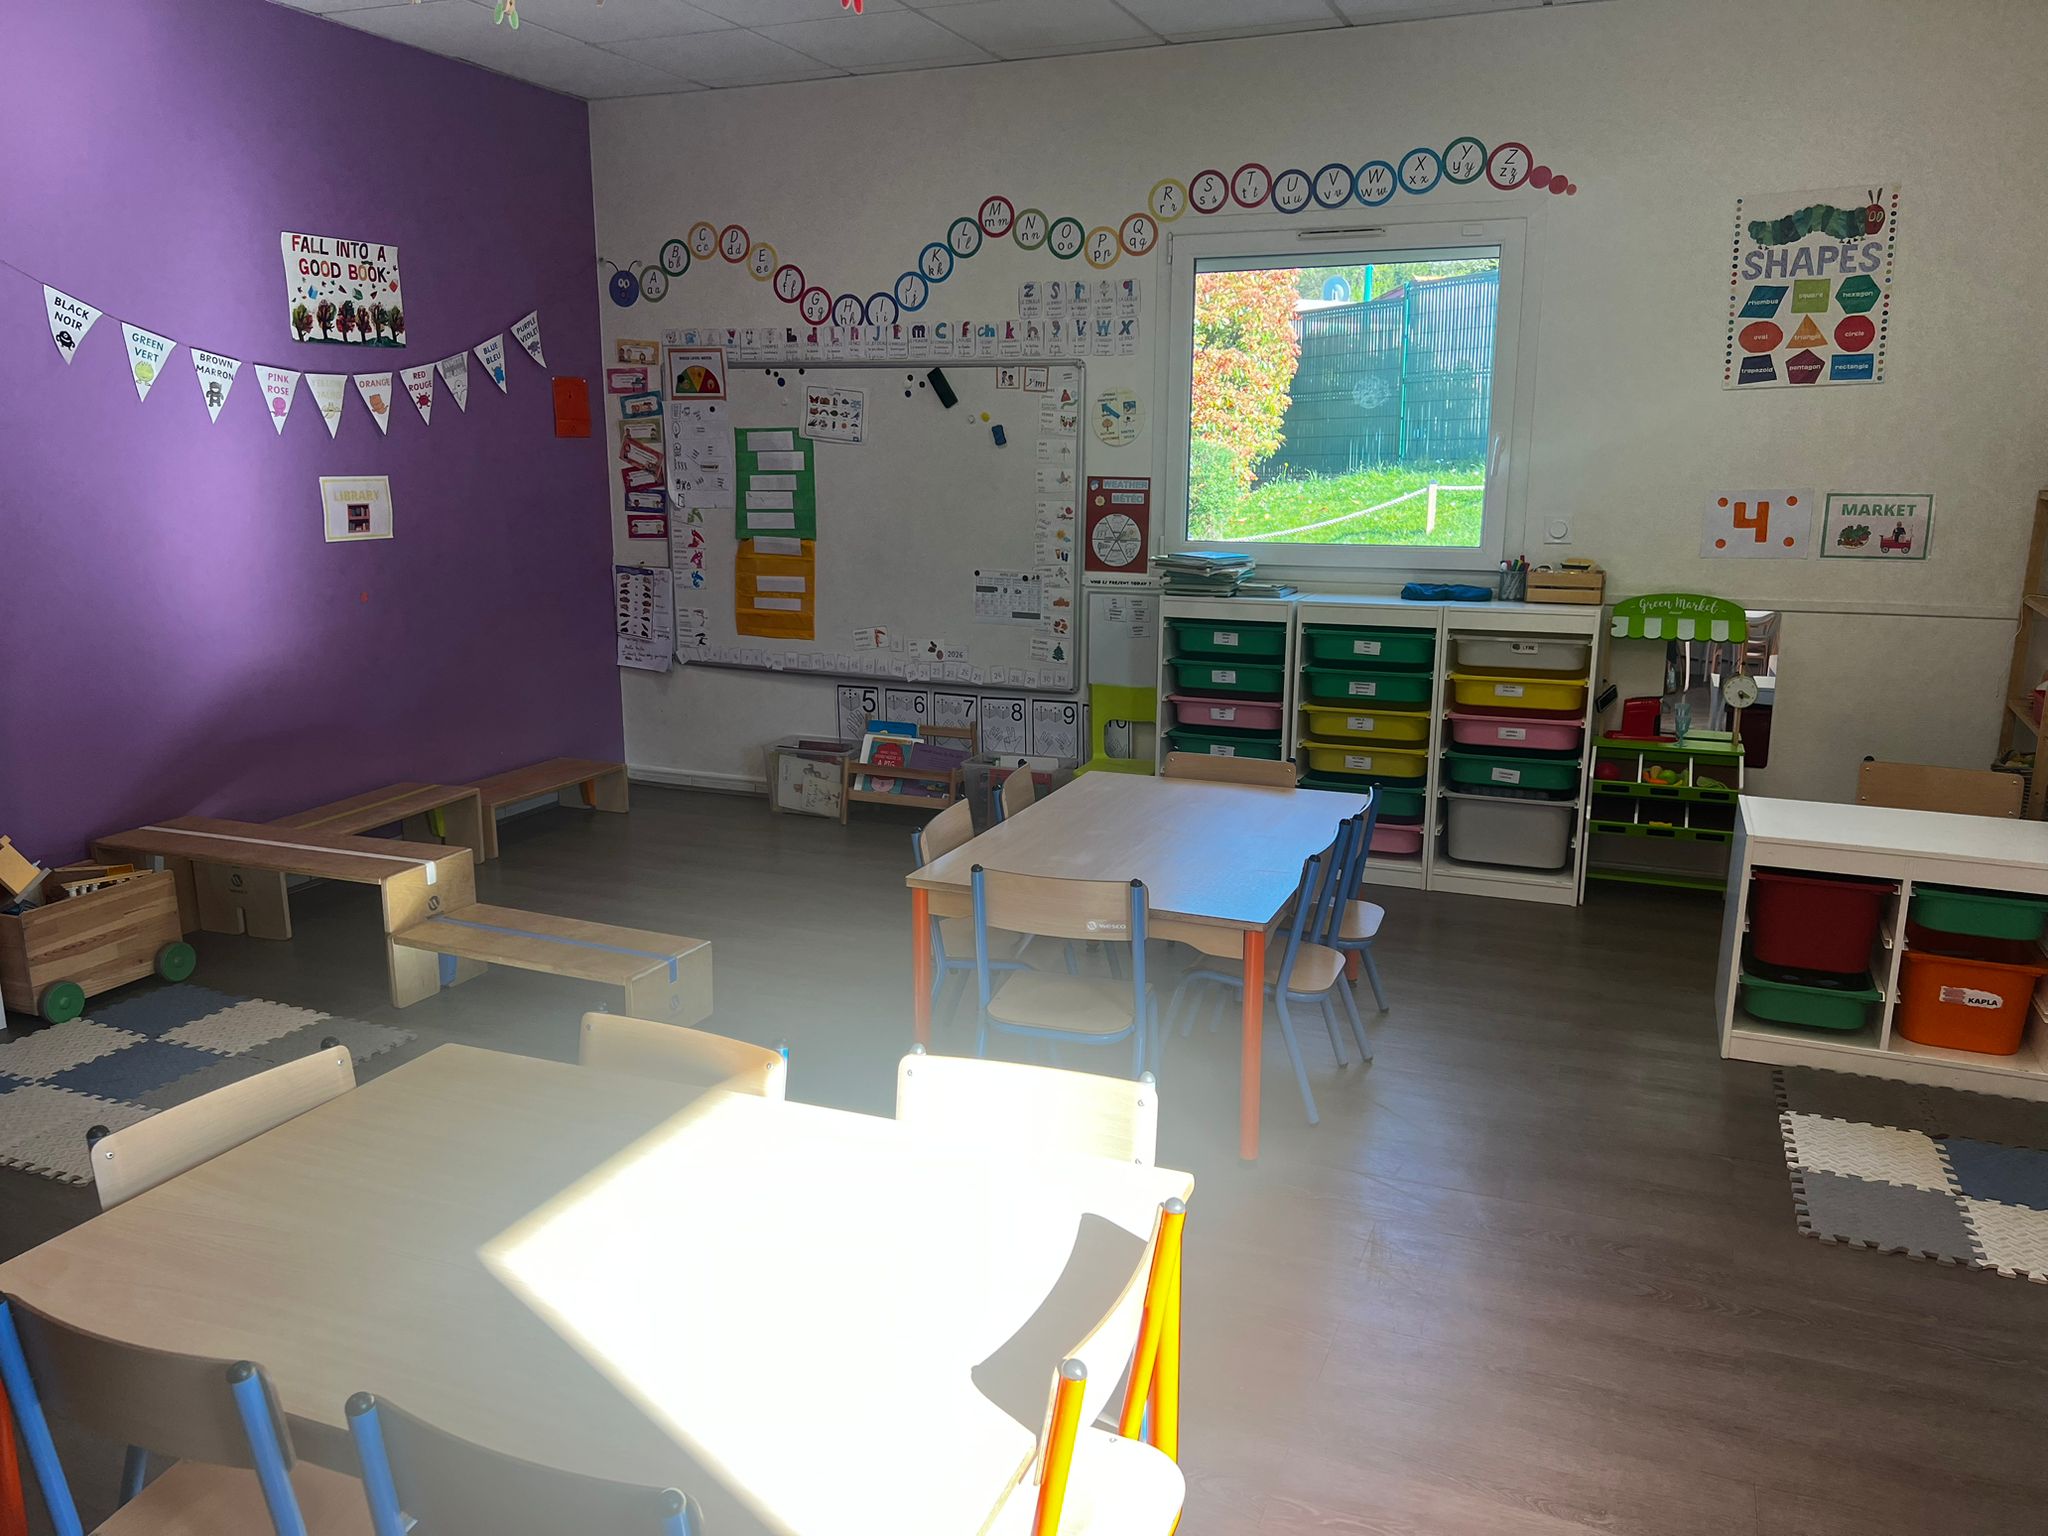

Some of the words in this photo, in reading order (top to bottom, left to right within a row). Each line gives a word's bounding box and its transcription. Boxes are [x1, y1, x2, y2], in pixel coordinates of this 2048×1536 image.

[292, 234, 329, 256] FALL
[336, 240, 368, 260] INTO
[377, 246, 386, 262] A
[1741, 242, 1884, 280] SHAPES
[299, 258, 341, 278] GOOD
[348, 263, 387, 283] BOOK
[1748, 298, 1779, 306] rhombus
[1842, 290, 1873, 298] hexagon
[54, 296, 90, 320] BLACK
[54, 311, 83, 331] NOIR
[516, 317, 536, 335] PURPLE
[132, 332, 164, 351] GREEN
[520, 327, 539, 344] VIOLET
[134, 347, 159, 363] VERT
[483, 342, 498, 355] BLUE
[200, 353, 233, 369] BROWN
[485, 353, 501, 365] BLEU
[196, 365, 234, 381] MARRON
[268, 372, 289, 383] PINK
[413, 371, 426, 380] RED
[1741, 367, 1774, 375] trapezoid
[1789, 364, 1821, 372] pentagon
[267, 385, 289, 396] ROSE
[359, 378, 390, 389] ORANGE
[408, 381, 432, 392] ROUGE
[1104, 480, 1148, 489] WEATHER
[334, 490, 379, 501] LIBRARY
[1841, 503, 1917, 517] MARKET
[1733, 501, 1770, 543] 4
[1639, 599, 1672, 614] Green
[1676, 597, 1719, 614] Market
[947, 651, 964, 659] 2026
[862, 690, 876, 712] 5
[913, 694, 926, 713] 6
[963, 700, 975, 718] 7
[1010, 704, 1023, 721] 8
[1063, 706, 1075, 724] 9
[1968, 998, 1998, 1006] KAPLA
